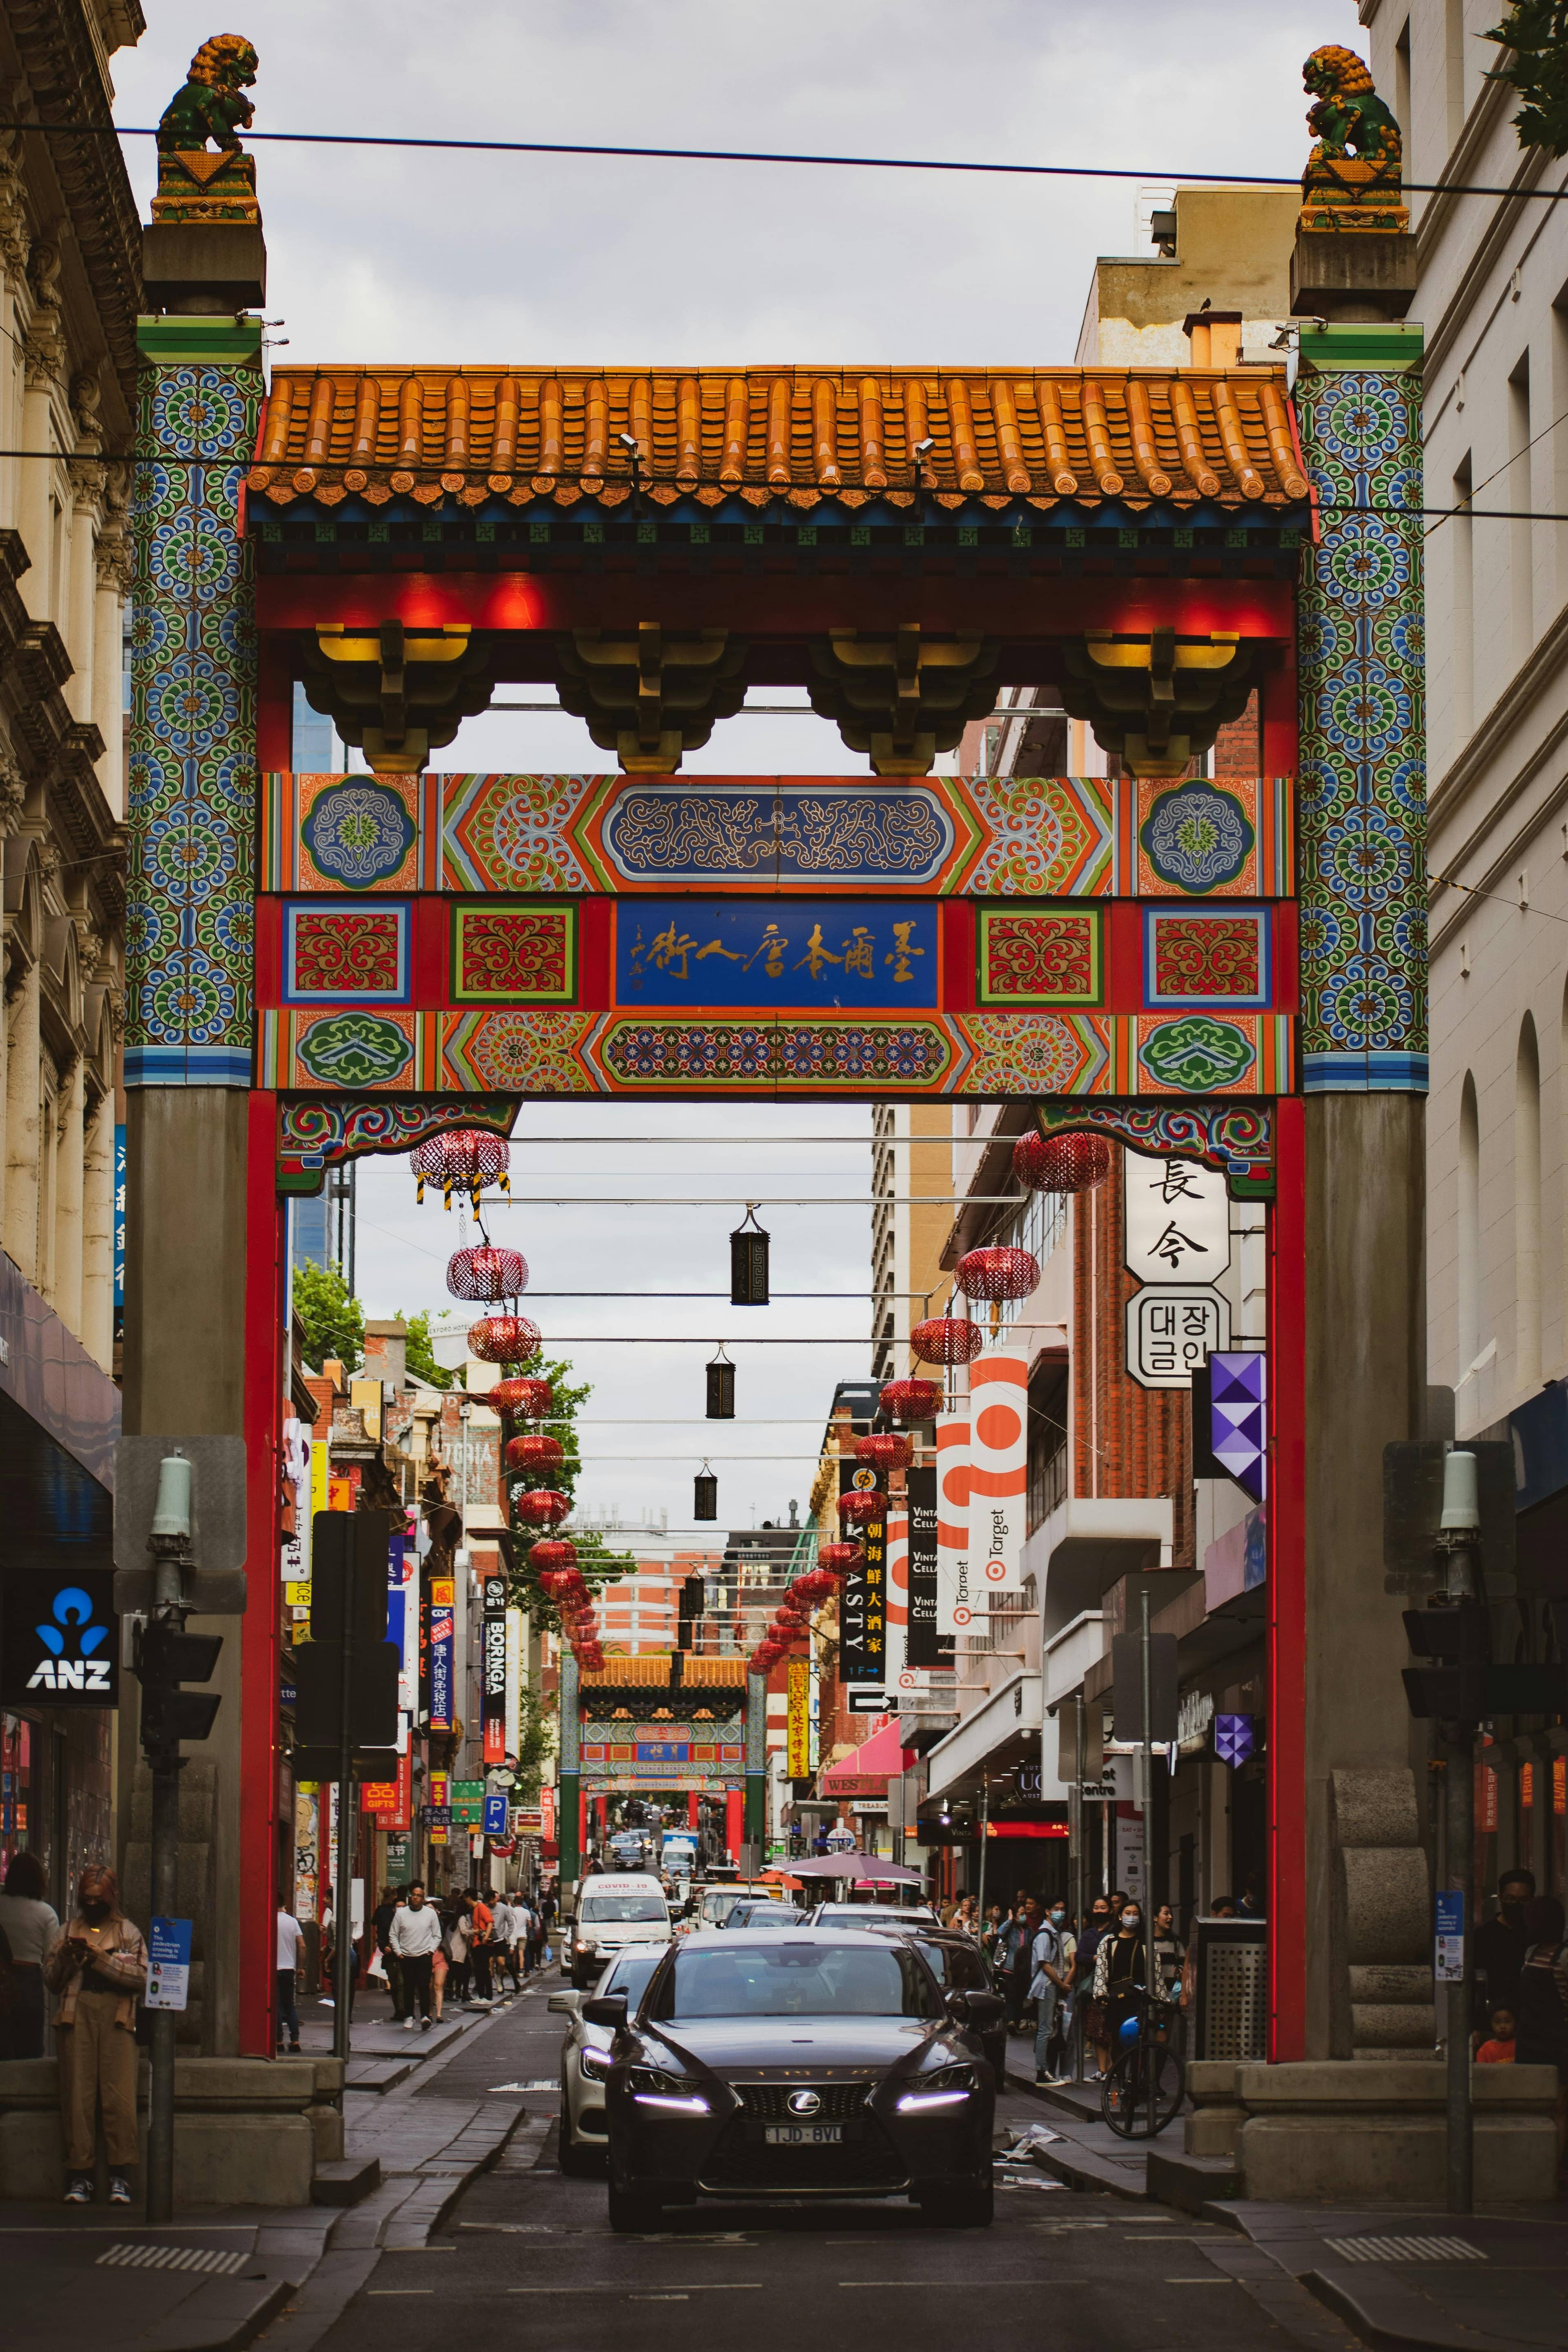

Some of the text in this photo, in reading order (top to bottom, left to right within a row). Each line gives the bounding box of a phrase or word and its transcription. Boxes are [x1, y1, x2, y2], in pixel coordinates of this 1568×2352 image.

[1150, 1306, 1210, 1336] 대장
[989, 1510, 1008, 1558] Target
[866, 1523, 882, 1653] 朝海鮮大酒家
[956, 1561, 969, 1605] Target
[26, 1660, 111, 1690] ANZ
[490, 1622, 505, 1695] BORNGA
[281, 1689, 296, 1698] tte
[490, 1800, 503, 1815] P
